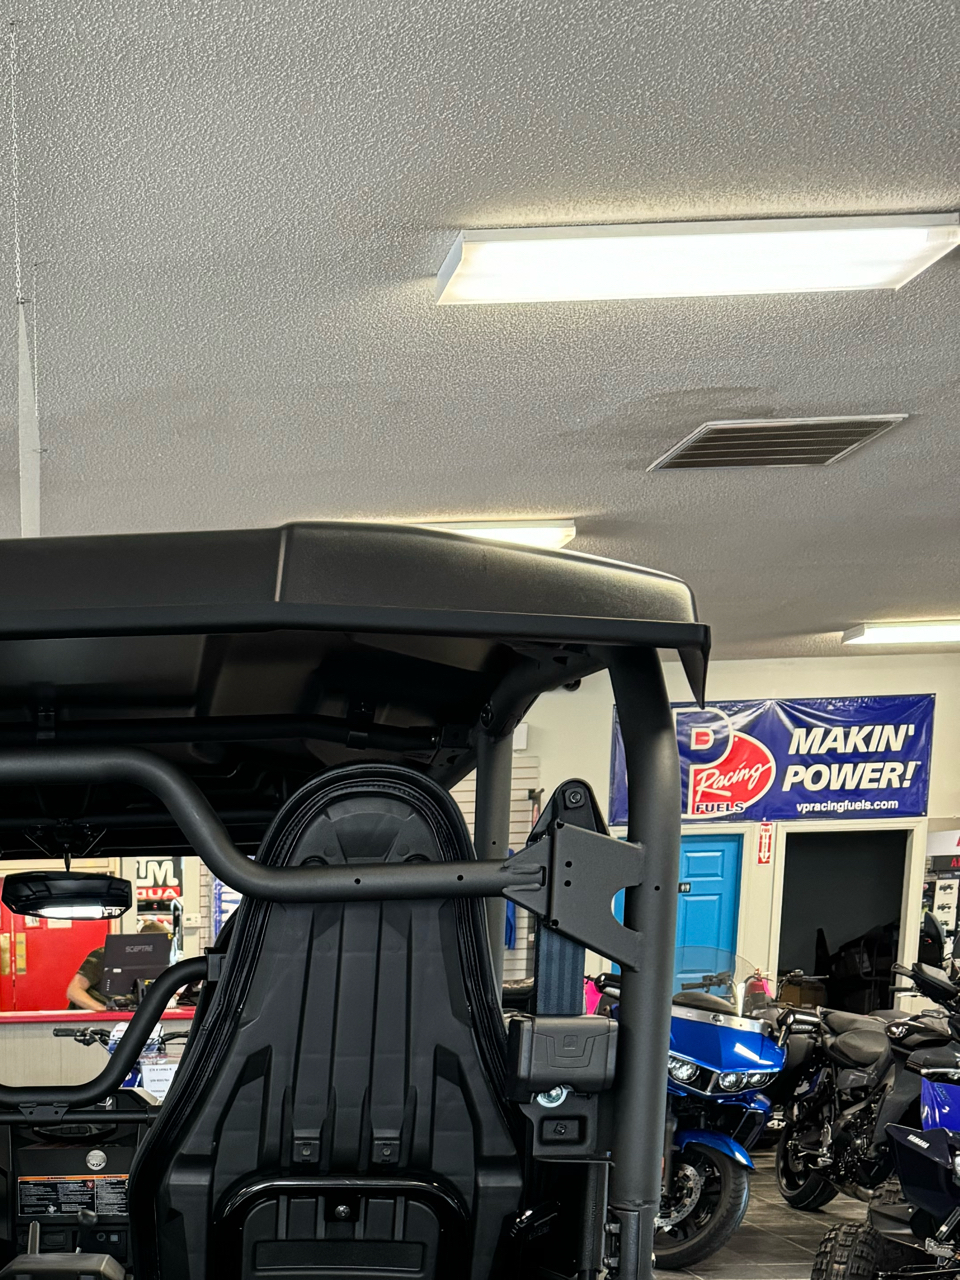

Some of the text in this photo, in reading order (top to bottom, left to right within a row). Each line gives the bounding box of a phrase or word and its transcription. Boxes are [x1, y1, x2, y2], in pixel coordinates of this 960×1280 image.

[788, 724, 915, 755] MAKIN'
[696, 761, 768, 802] Racing
[782, 761, 916, 791] POWER!
[695, 801, 746, 813] FUELS
[796, 799, 899, 814] vpracingfuels.com
[137, 859, 180, 887] TM
[907, 1134, 930, 1149] YAMAHA
